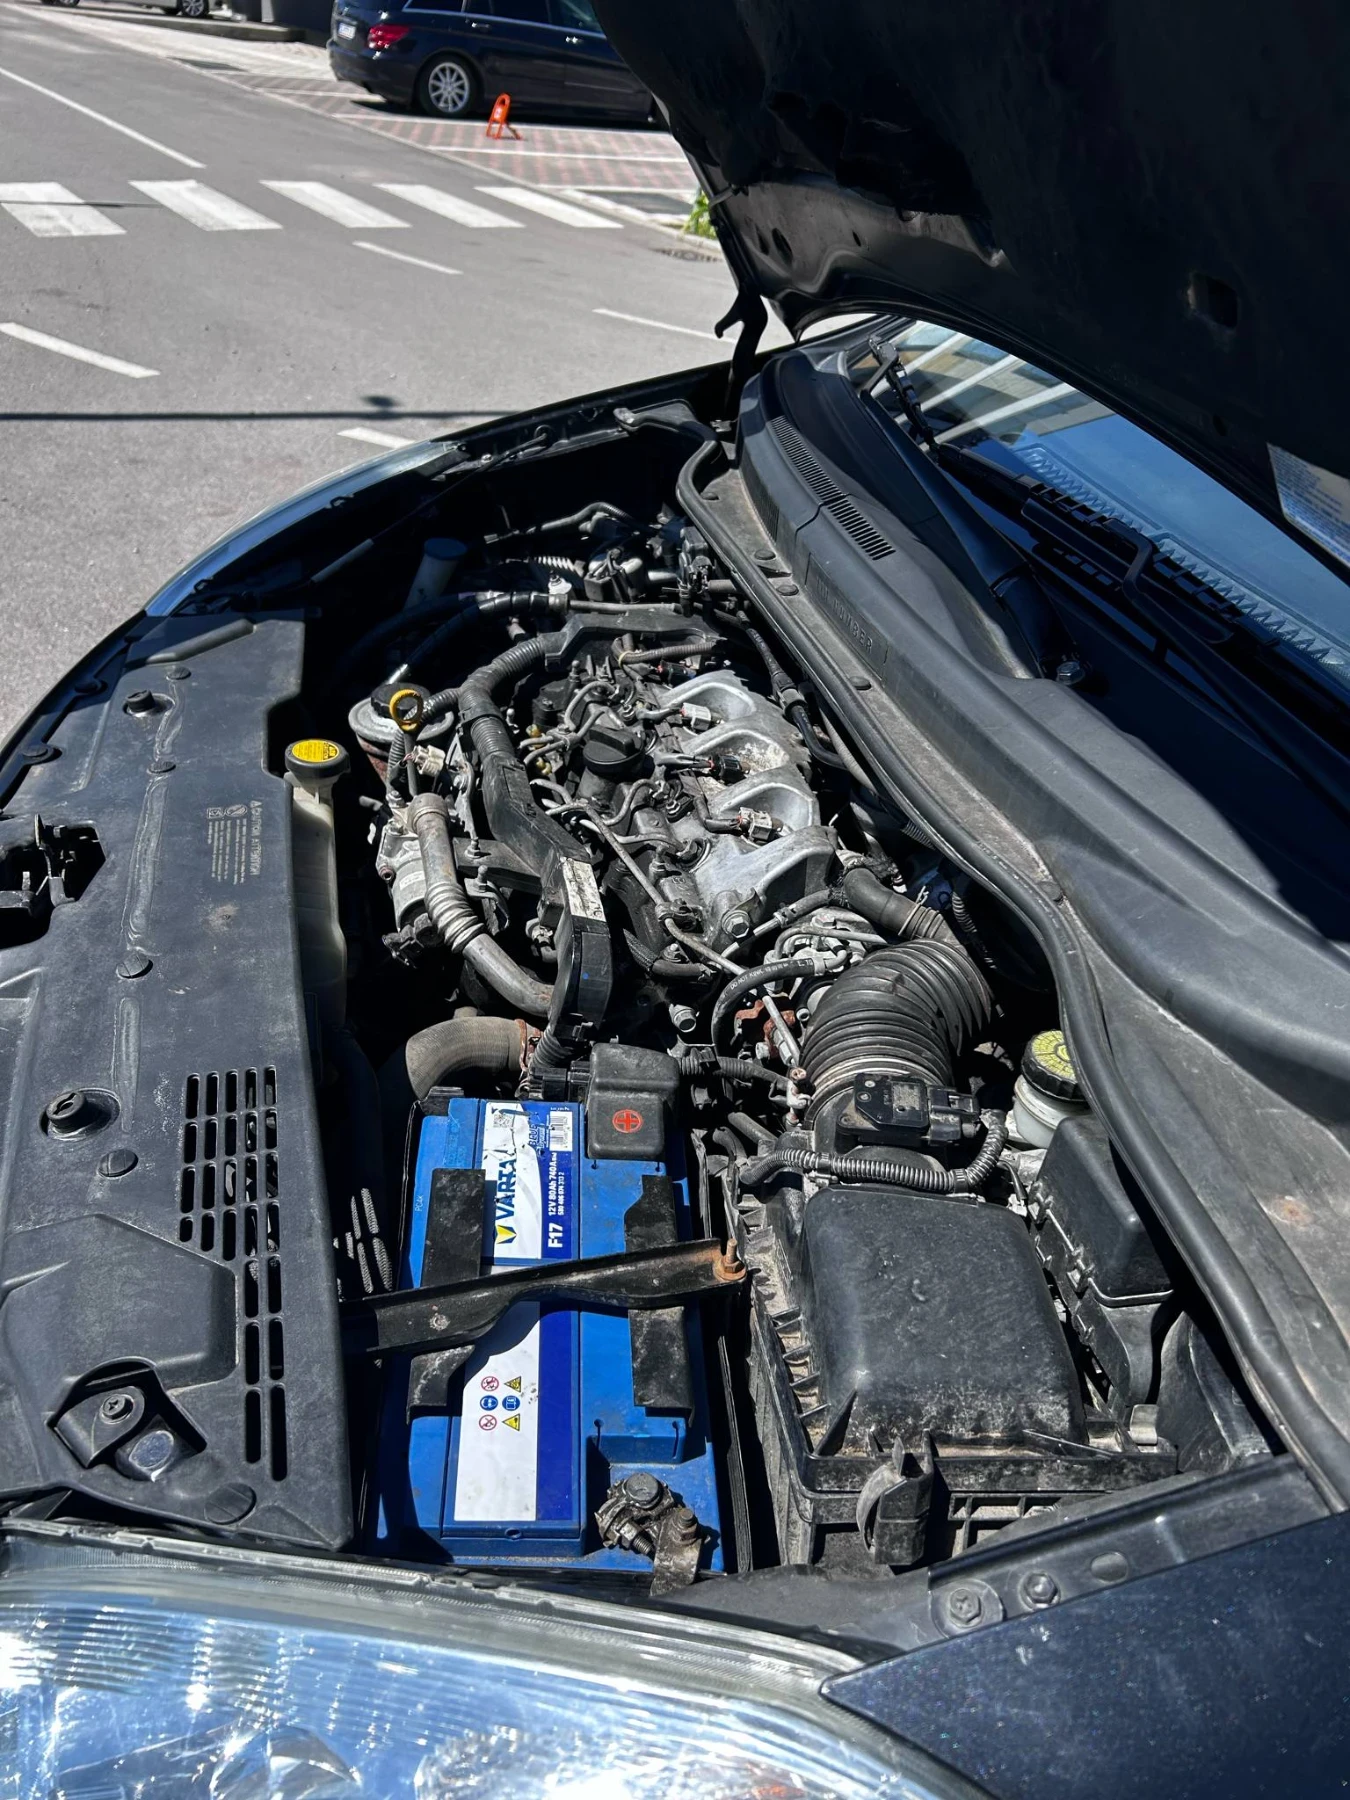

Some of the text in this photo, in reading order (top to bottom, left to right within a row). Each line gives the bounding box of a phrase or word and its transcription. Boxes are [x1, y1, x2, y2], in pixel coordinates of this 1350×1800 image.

[832, 599, 873, 654] NUMBER
[496, 1158, 516, 1220] VARTA
[548, 1180, 557, 1200] 80Ah
[548, 1201, 557, 1216] 12V
[548, 1222, 563, 1248] F17
